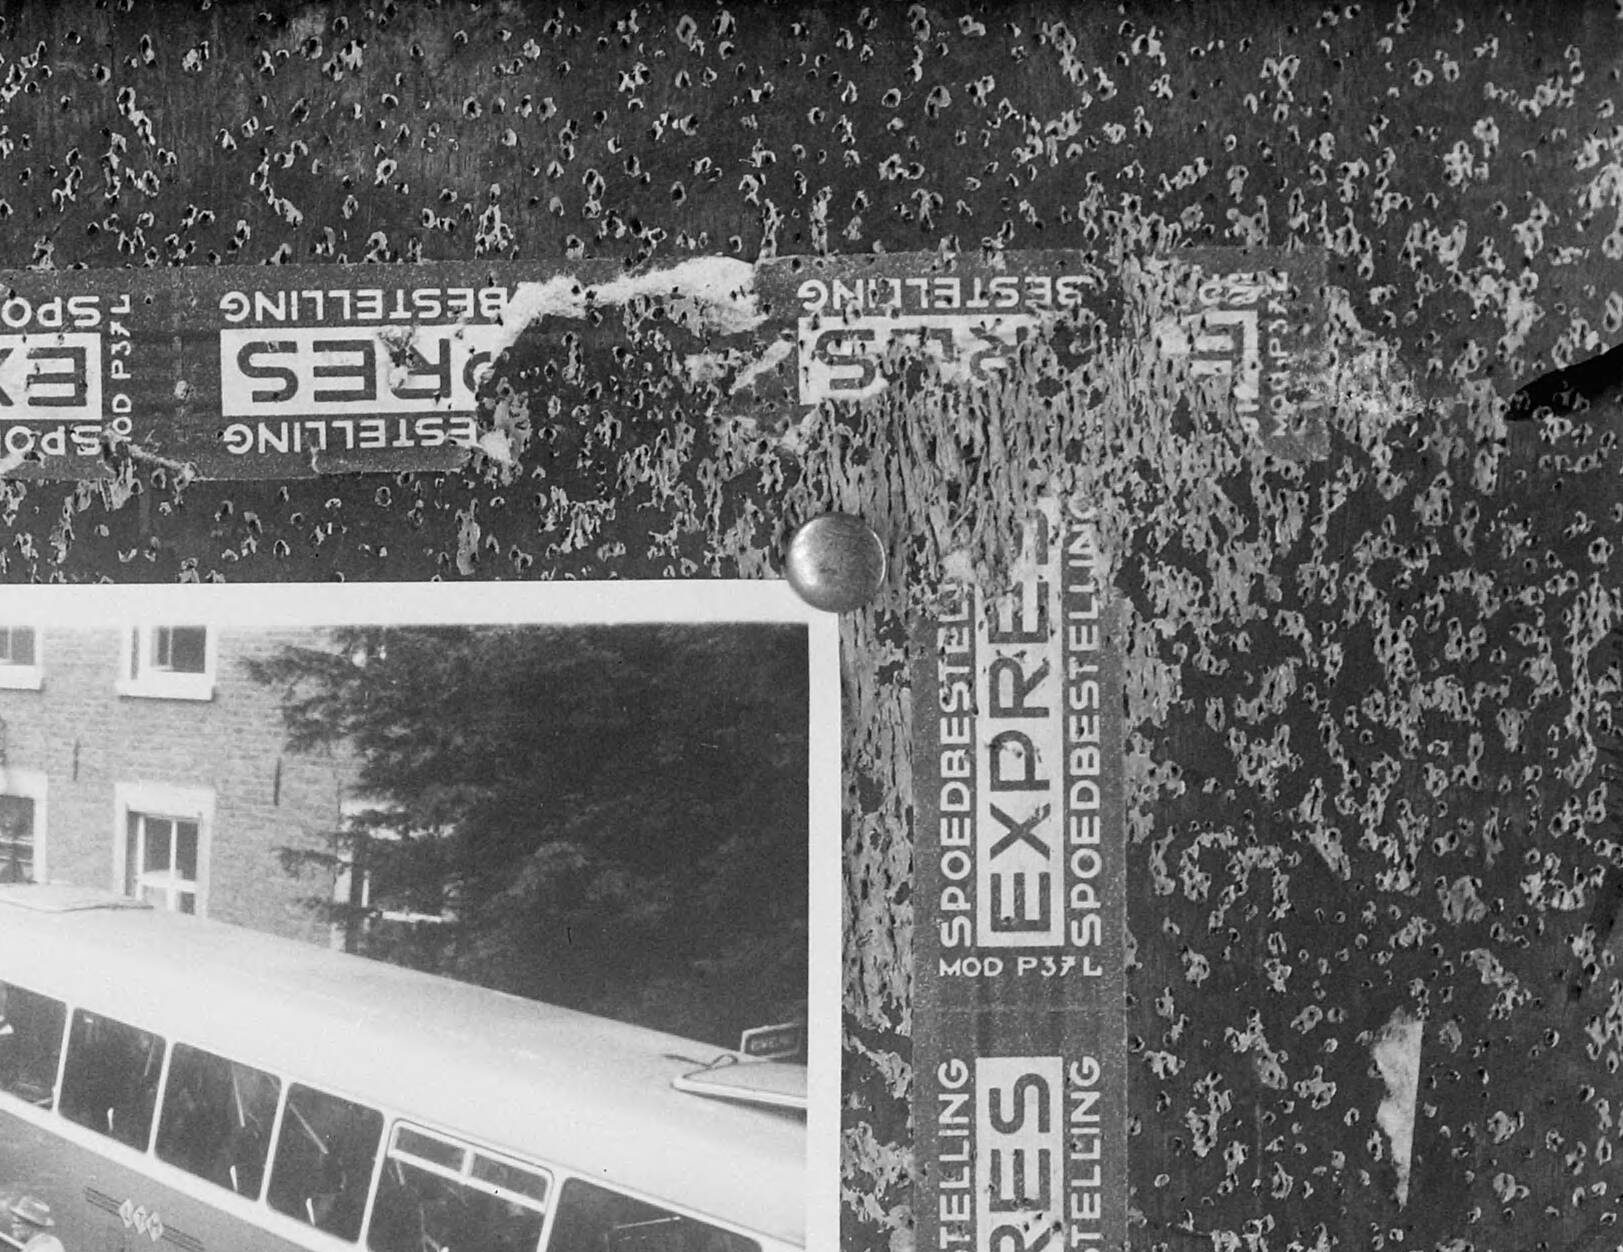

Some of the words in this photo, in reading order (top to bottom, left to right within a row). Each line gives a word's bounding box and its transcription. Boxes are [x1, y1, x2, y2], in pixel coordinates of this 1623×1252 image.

[220, 285, 506, 324] BESTELLING
[110, 294, 132, 379] P37L
[223, 420, 478, 457] ESTELLING
[939, 956, 1004, 977] MOD
